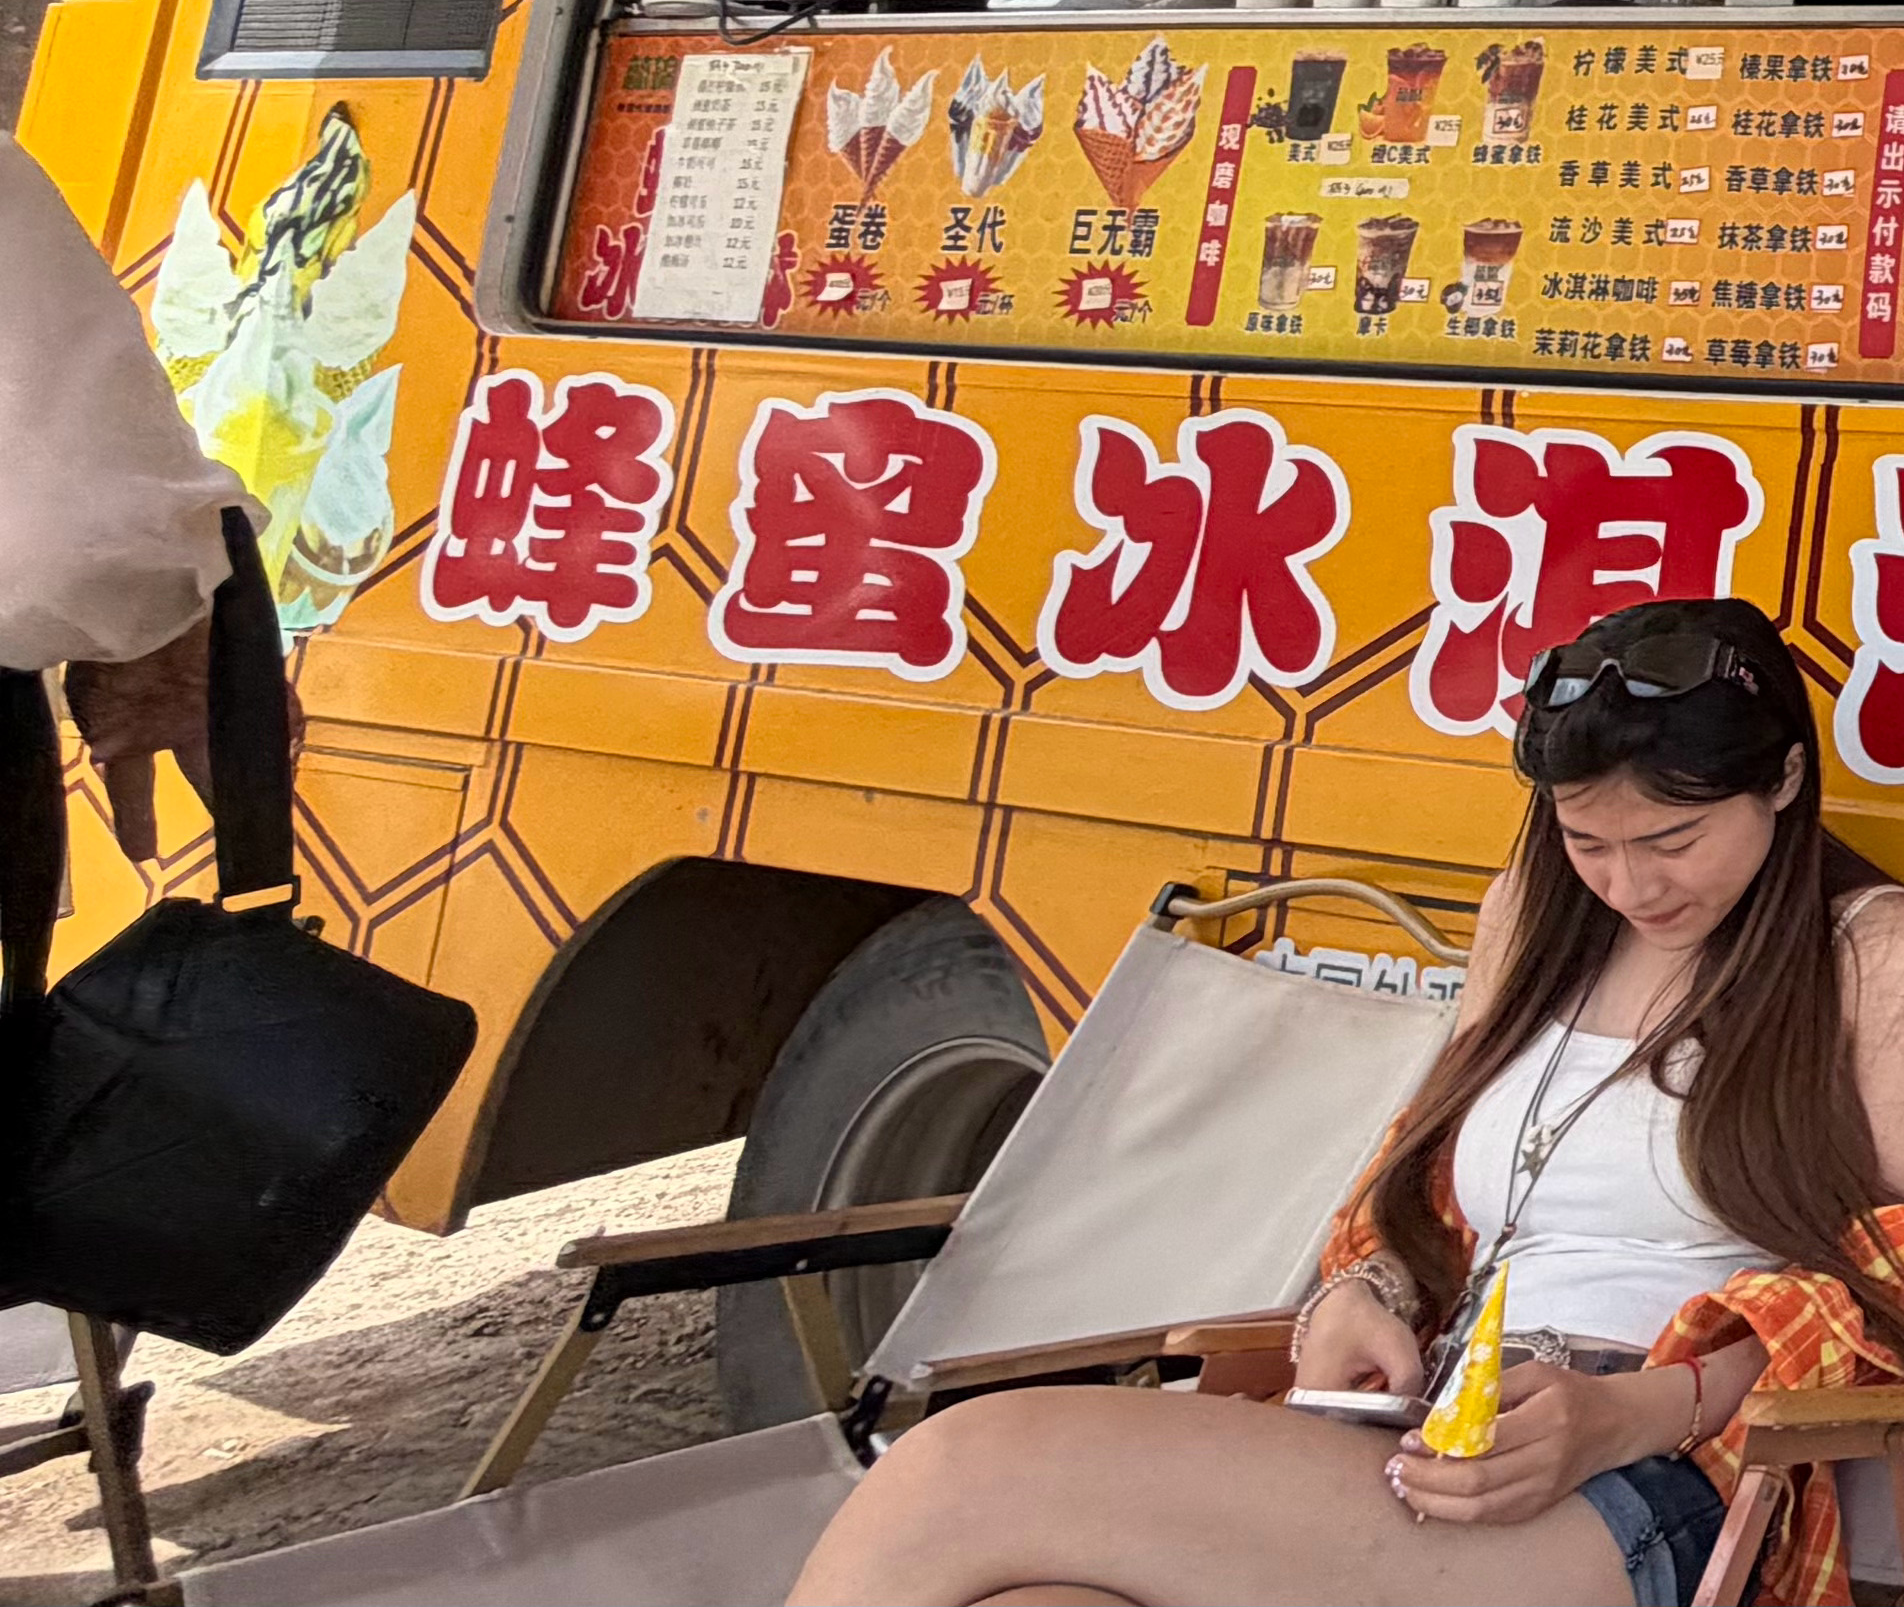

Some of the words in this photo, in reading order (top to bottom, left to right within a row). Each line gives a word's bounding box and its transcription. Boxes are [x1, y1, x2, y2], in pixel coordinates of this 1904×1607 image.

[1573, 45, 1688, 77] 柠檬美式
[1739, 54, 1832, 82] 榛果拿铁
[1566, 103, 1680, 132] 桂花美式
[1731, 108, 1825, 138] 桂花拿铁
[1471, 144, 1542, 165] 蜂蜜拿铁
[1558, 160, 1673, 190] 香草美式
[1725, 165, 1818, 196] 香草拿铁
[1198, 123, 1243, 268] 现磨咖啡
[826, 204, 888, 251] 蛋卷
[940, 206, 1006, 253] 圣代
[1069, 208, 1160, 258] 巨无霸
[1549, 216, 1665, 247] 流沙美式
[1717, 221, 1812, 253] 抹茶拿铁
[1541, 273, 1659, 304] 冰淇淋咖啡
[1711, 279, 1806, 311] 焦糖拿铁
[1356, 316, 1388, 336] 摩卡
[1533, 328, 1652, 363] 茉莉花拿铁
[1705, 337, 1801, 369] 草莓拿铁
